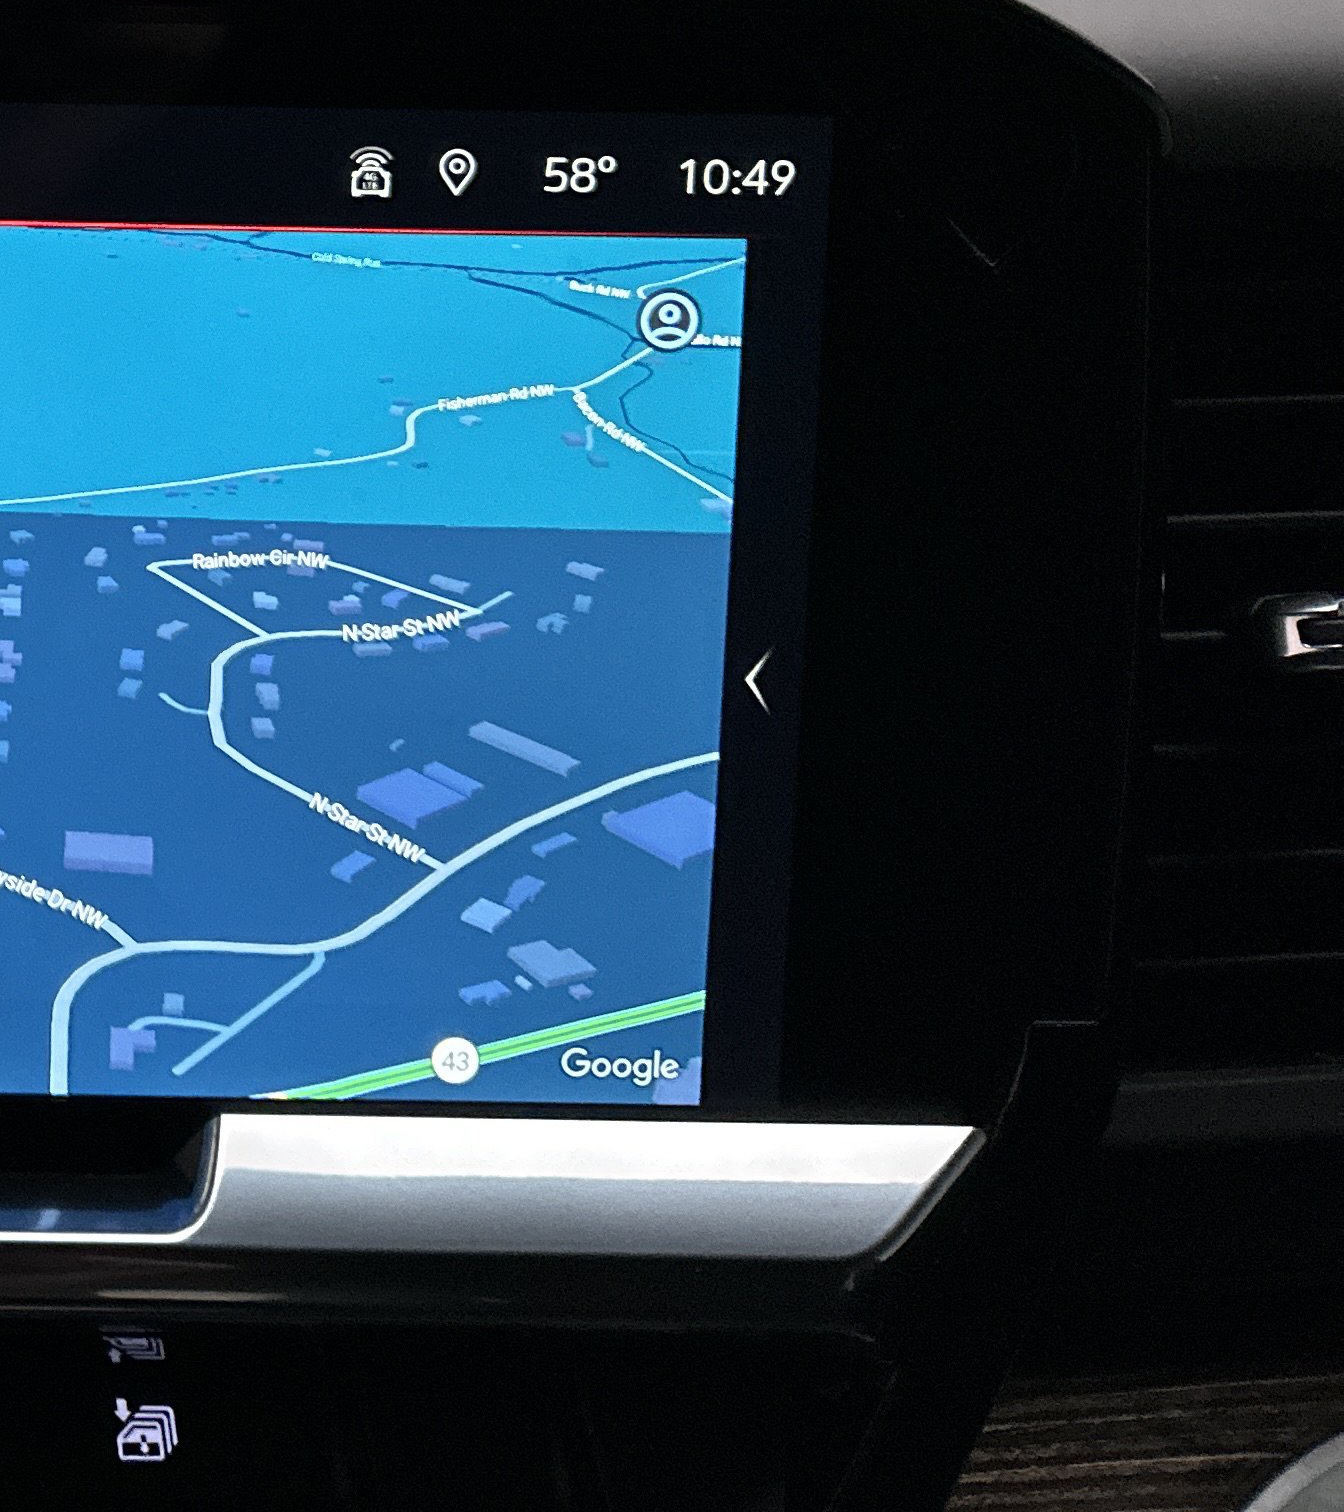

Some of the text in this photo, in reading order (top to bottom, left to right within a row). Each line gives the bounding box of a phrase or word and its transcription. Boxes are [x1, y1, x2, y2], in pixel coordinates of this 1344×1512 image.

[363, 172, 379, 181] 4G
[543, 155, 618, 193] 58°
[679, 158, 797, 195] 10:49
[437, 384, 555, 412] Fisherman Rd NW
[603, 421, 624, 440] Rd
[621, 432, 646, 452] NW
[192, 551, 264, 569] Rainbow
[296, 550, 329, 569] NW
[341, 608, 461, 643] N Star St NW
[308, 791, 427, 864] N Star St NW
[47, 888, 76, 913] Dr
[71, 899, 110, 931] NW
[441, 1050, 471, 1073] 43
[561, 1046, 680, 1087] Google
